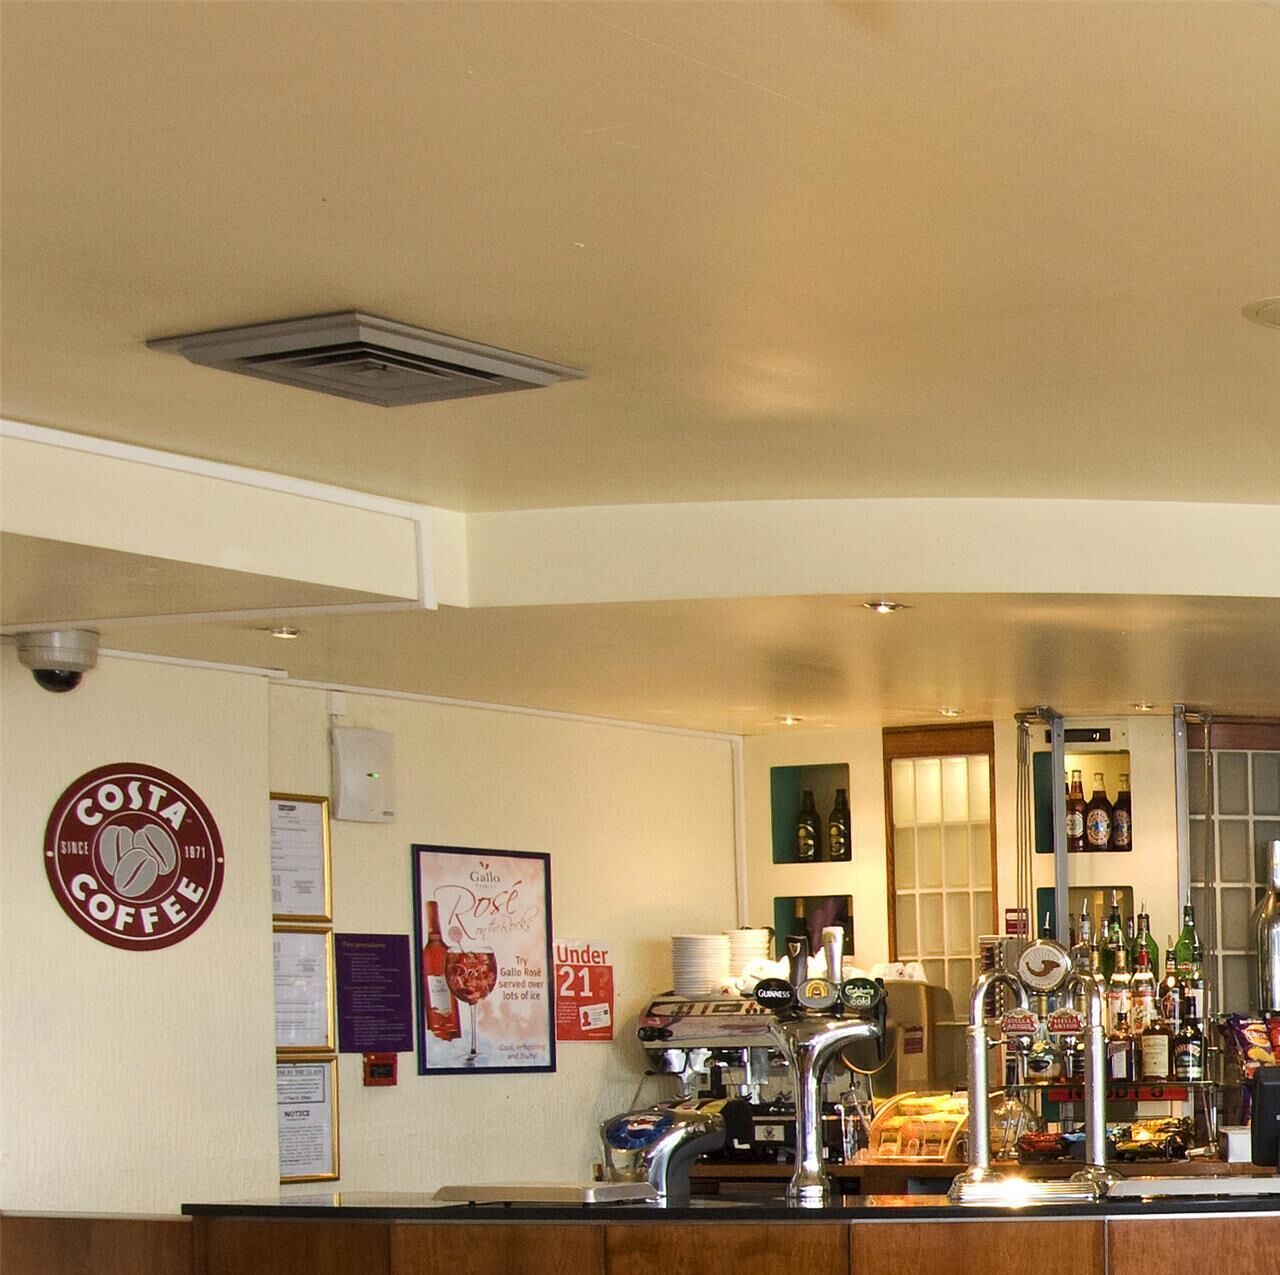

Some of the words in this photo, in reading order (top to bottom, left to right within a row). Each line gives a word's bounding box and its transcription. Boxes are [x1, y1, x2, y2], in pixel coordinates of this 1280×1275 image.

[77, 781, 187, 831] COSTA
[61, 841, 89, 855] SINCE
[184, 846, 207, 859] 1971
[470, 871, 501, 882] Gallo
[71, 874, 205, 934] COFFEE
[433, 880, 522, 941] Rosé
[557, 944, 608, 964] Under
[515, 955, 528, 967] Try
[500, 967, 522, 977] Gallo
[524, 967, 542, 977] Rosé
[498, 980, 526, 989] served
[528, 981, 544, 989] over
[558, 966, 593, 997] 21
[503, 991, 519, 1000] lots
[520, 991, 529, 1000] of
[530, 991, 541, 1000] ice
[758, 988, 791, 998] GUINNESS
[850, 996, 871, 1006] cold
[284, 1110, 310, 1118] NOTICE
